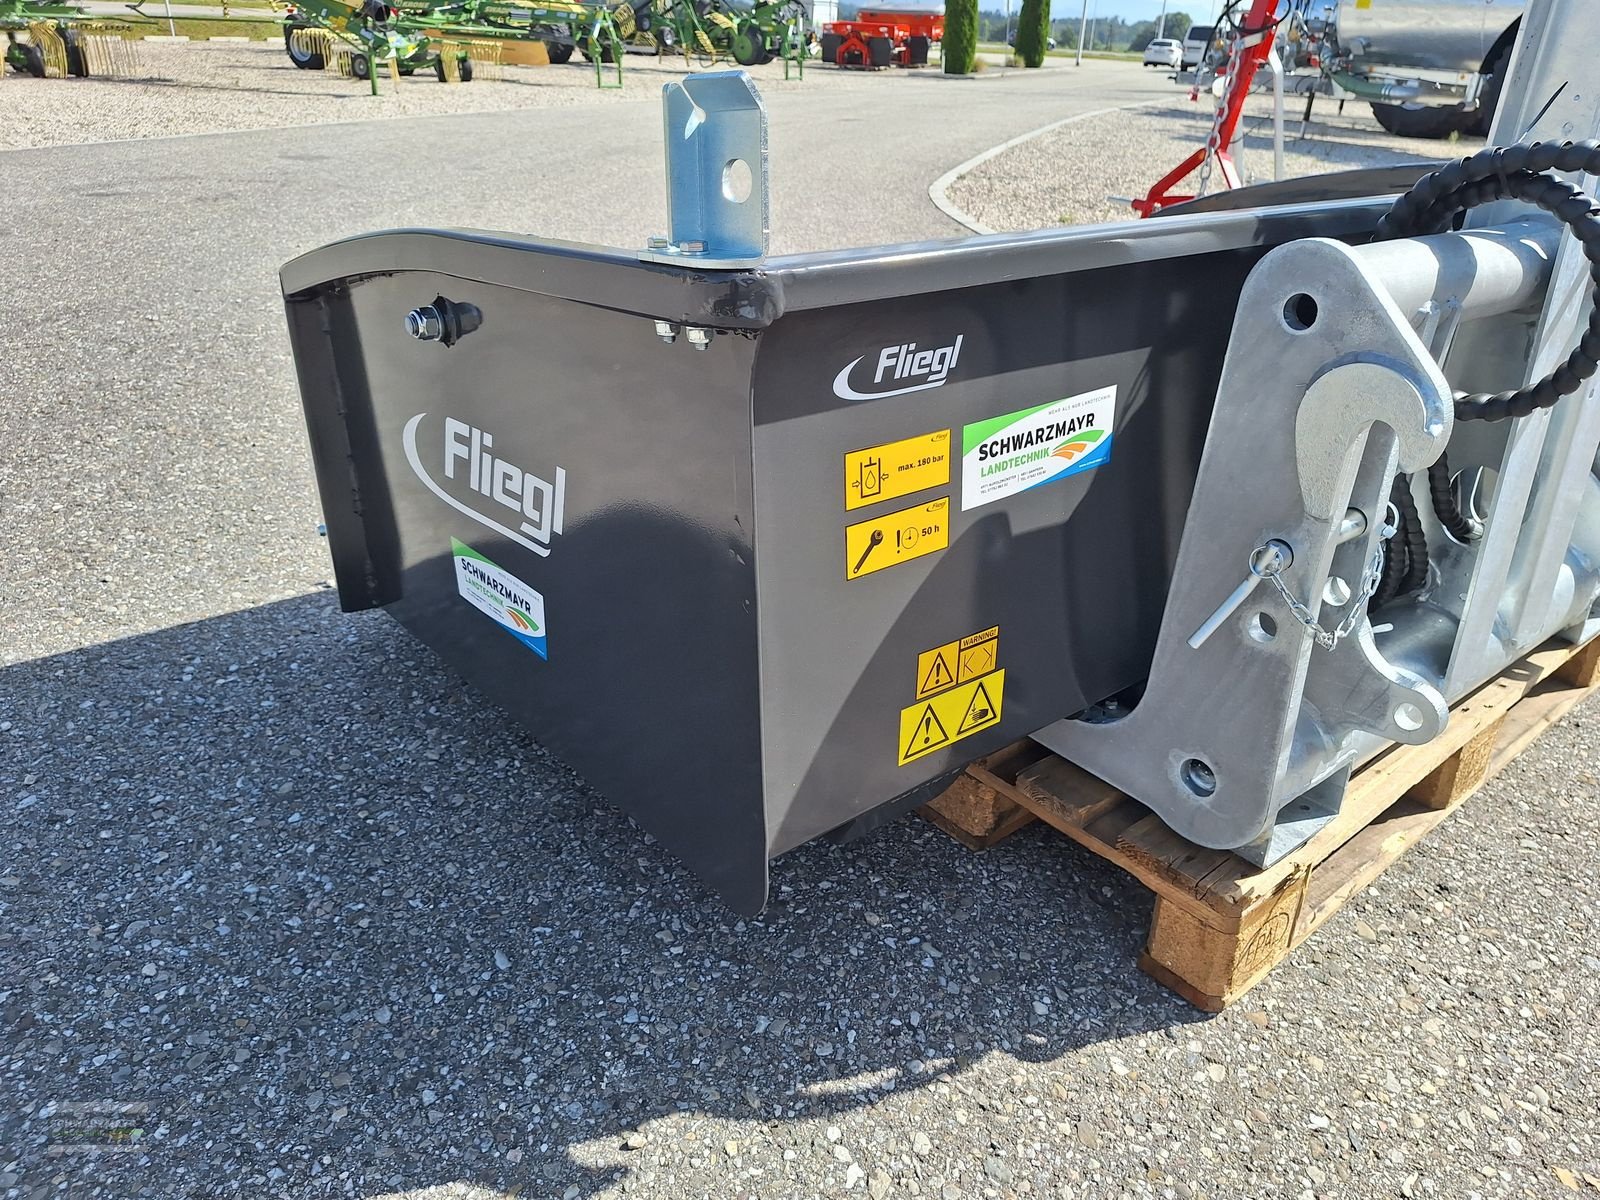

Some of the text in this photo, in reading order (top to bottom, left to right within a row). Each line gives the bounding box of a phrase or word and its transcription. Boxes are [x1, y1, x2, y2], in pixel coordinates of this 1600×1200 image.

[874, 334, 963, 383] Fliegl
[978, 412, 1095, 461] SCHWARZMAYR
[445, 417, 566, 544] Fliegl
[898, 463, 915, 472] max.
[918, 457, 930, 466] 180
[981, 447, 1050, 477] LANDTECHNIK
[922, 526, 932, 536] 50
[461, 558, 531, 614] SCHWARZMAYR
[963, 628, 997, 647] WARNING!
